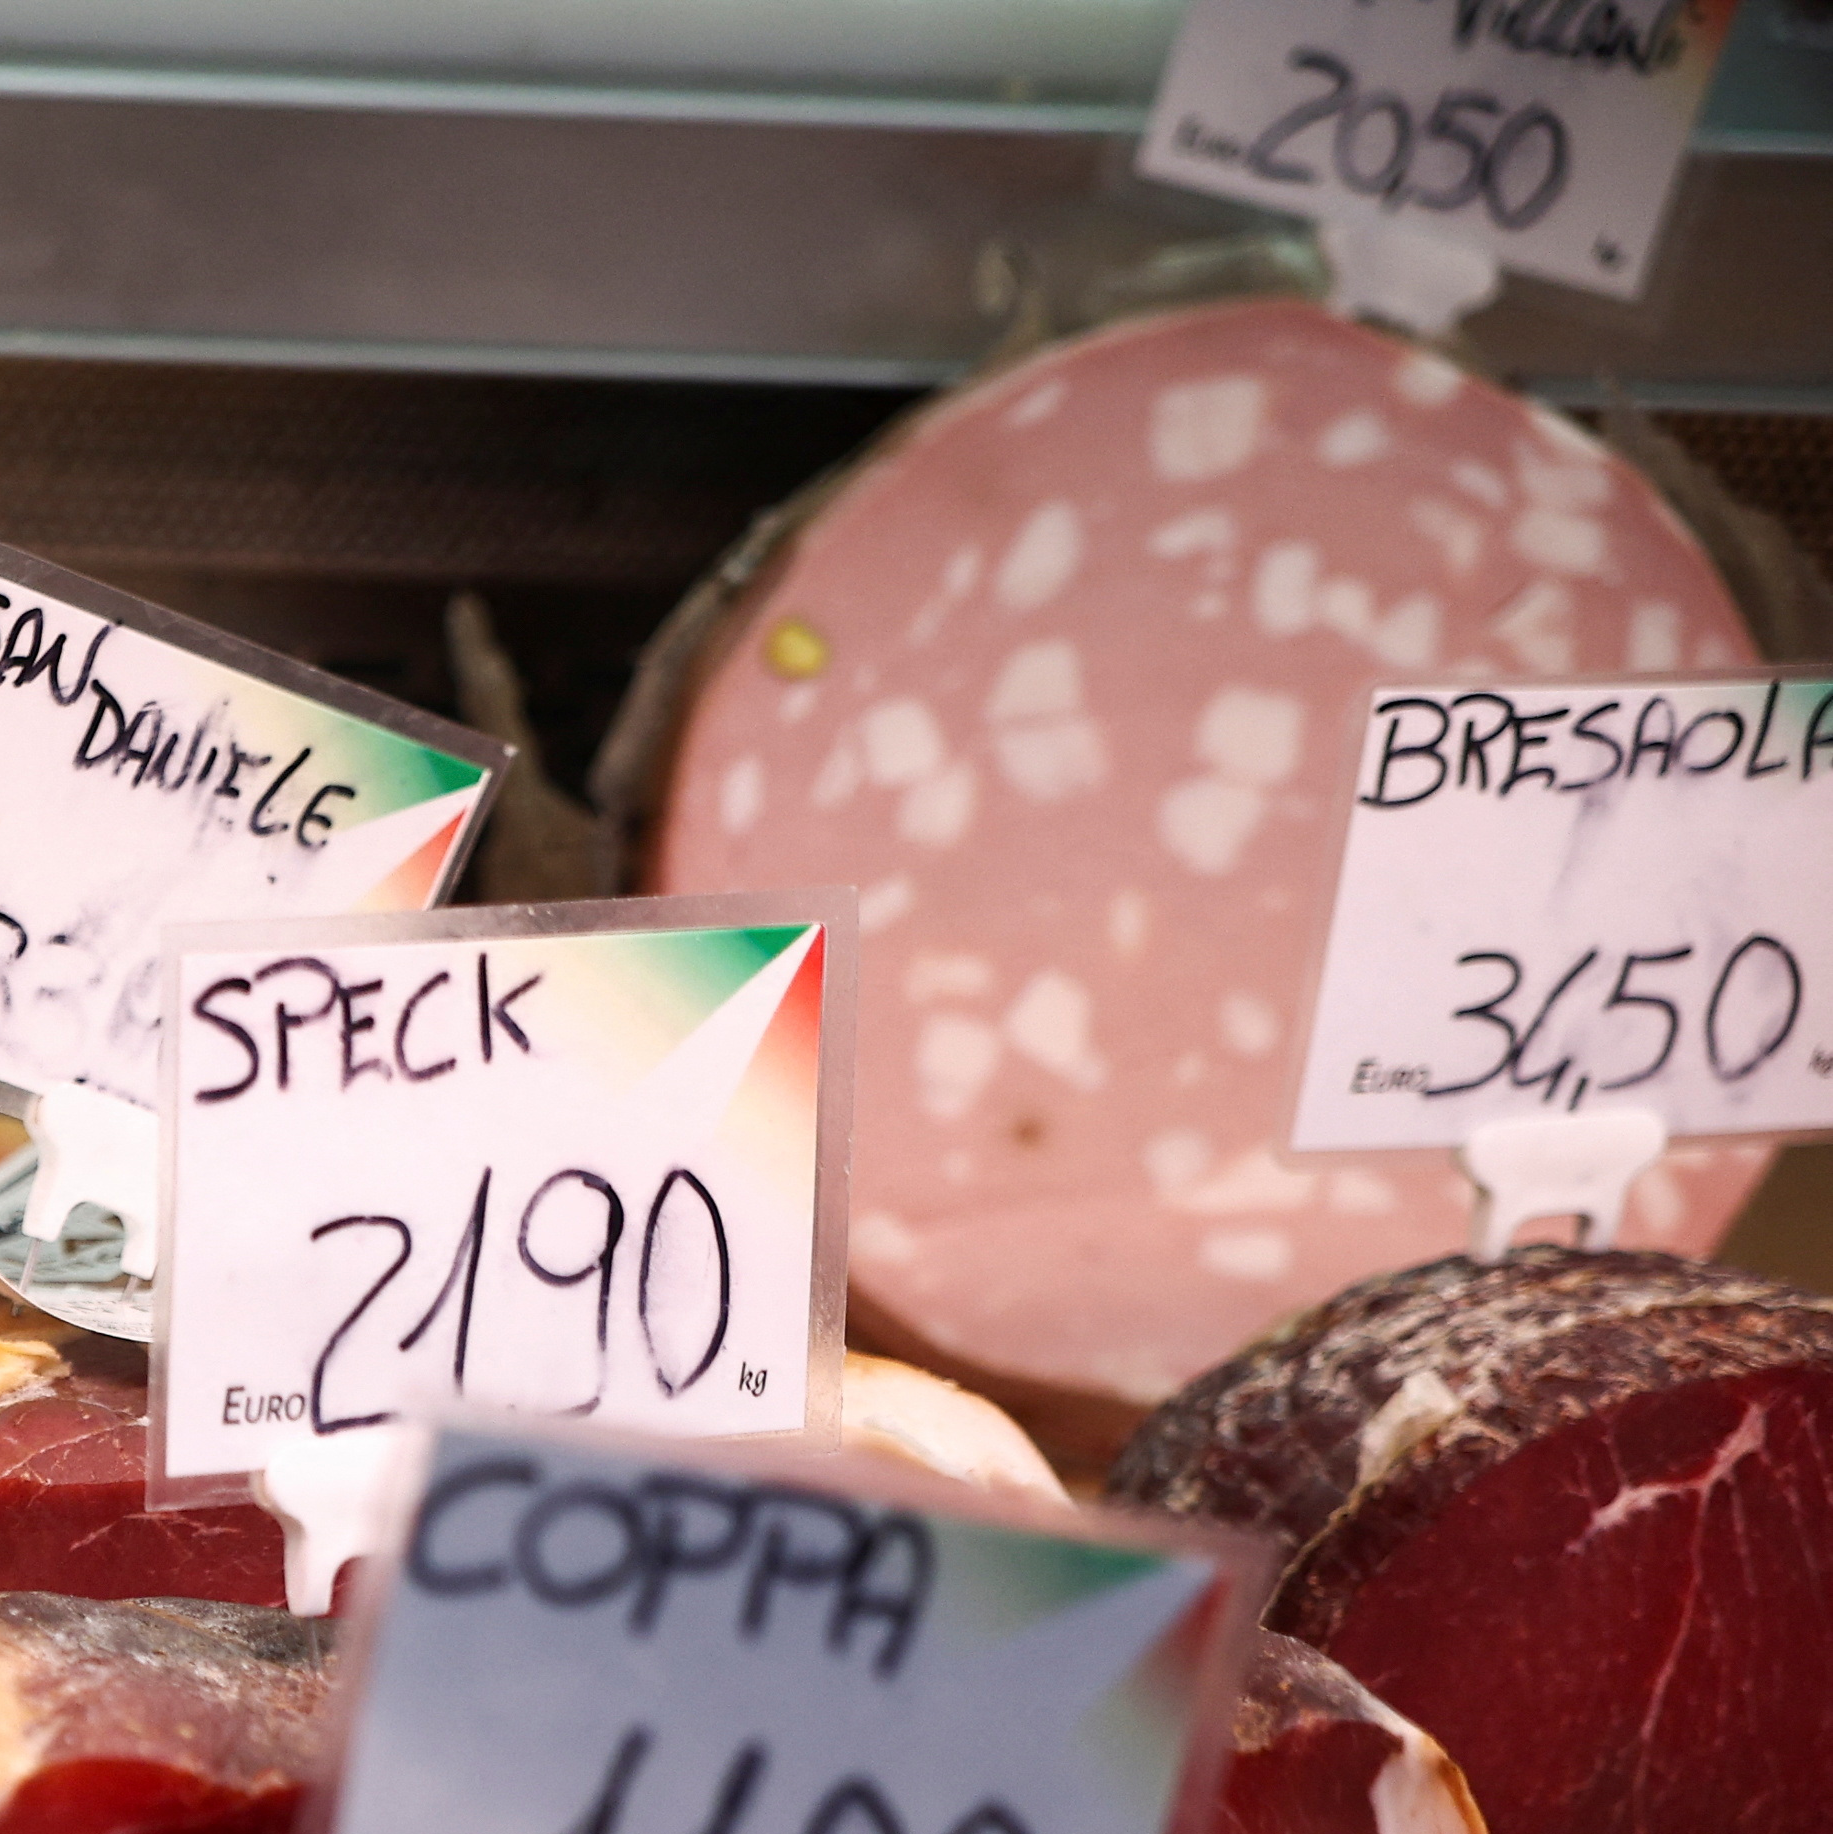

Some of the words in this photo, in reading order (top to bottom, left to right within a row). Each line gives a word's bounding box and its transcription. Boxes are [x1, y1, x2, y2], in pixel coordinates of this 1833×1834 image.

[73, 676, 355, 851] DANIELE
[192, 952, 545, 1104] SPECK
[737, 1362, 769, 1398] kg
[406, 1456, 938, 1684] COPPA
